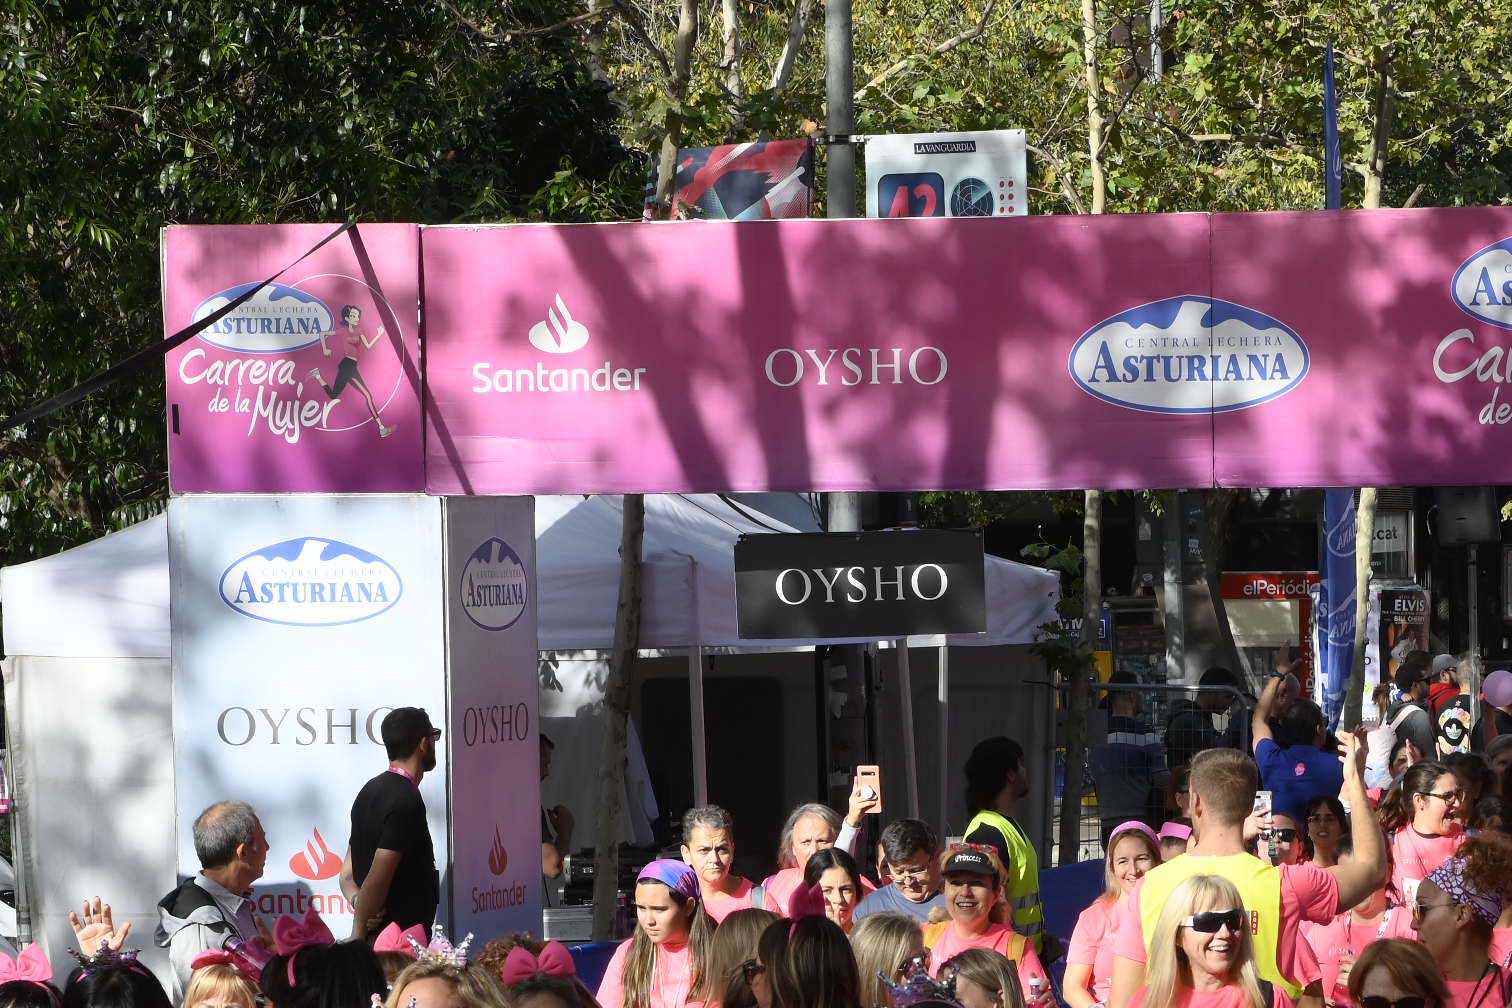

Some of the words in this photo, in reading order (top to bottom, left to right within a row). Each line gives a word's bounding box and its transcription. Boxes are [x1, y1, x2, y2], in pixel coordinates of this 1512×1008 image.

[1125, 336, 1199, 348] CENTRAL
[1207, 335, 1283, 347] LECHERA
[179, 349, 296, 385] Carrera
[473, 361, 646, 392] Santander
[765, 346, 947, 387] OYSHO
[1088, 340, 1290, 383] ASTURIANA
[209, 388, 228, 412] de
[236, 389, 250, 413] la
[249, 382, 340, 443] Mujer
[1478, 389, 1512, 425] de
[1374, 527, 1397, 540] .cat
[234, 571, 388, 603] ASTURIANA
[466, 571, 524, 607] ASTURIANA
[776, 563, 947, 605] OYSHO
[1394, 600, 1424, 611] ELVIS
[463, 703, 528, 746] OYSHO
[471, 882, 527, 913] Santander
